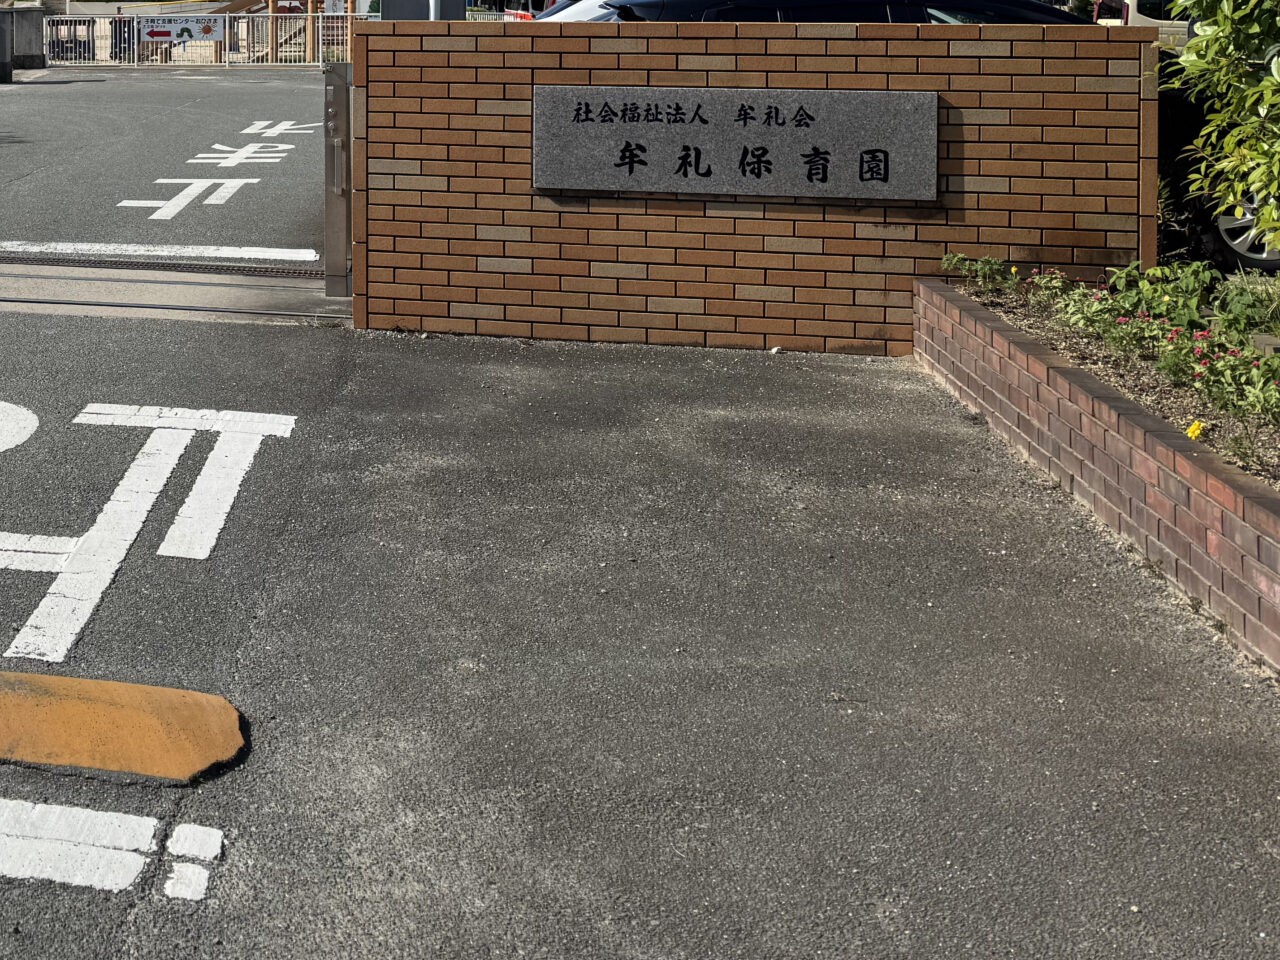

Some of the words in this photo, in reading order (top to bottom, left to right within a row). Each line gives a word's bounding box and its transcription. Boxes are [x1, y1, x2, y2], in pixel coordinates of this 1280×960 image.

[572, 101, 709, 126] 社会福祉法人
[733, 103, 816, 129] 牟礼会
[613, 141, 890, 184] 牟礼保育園
